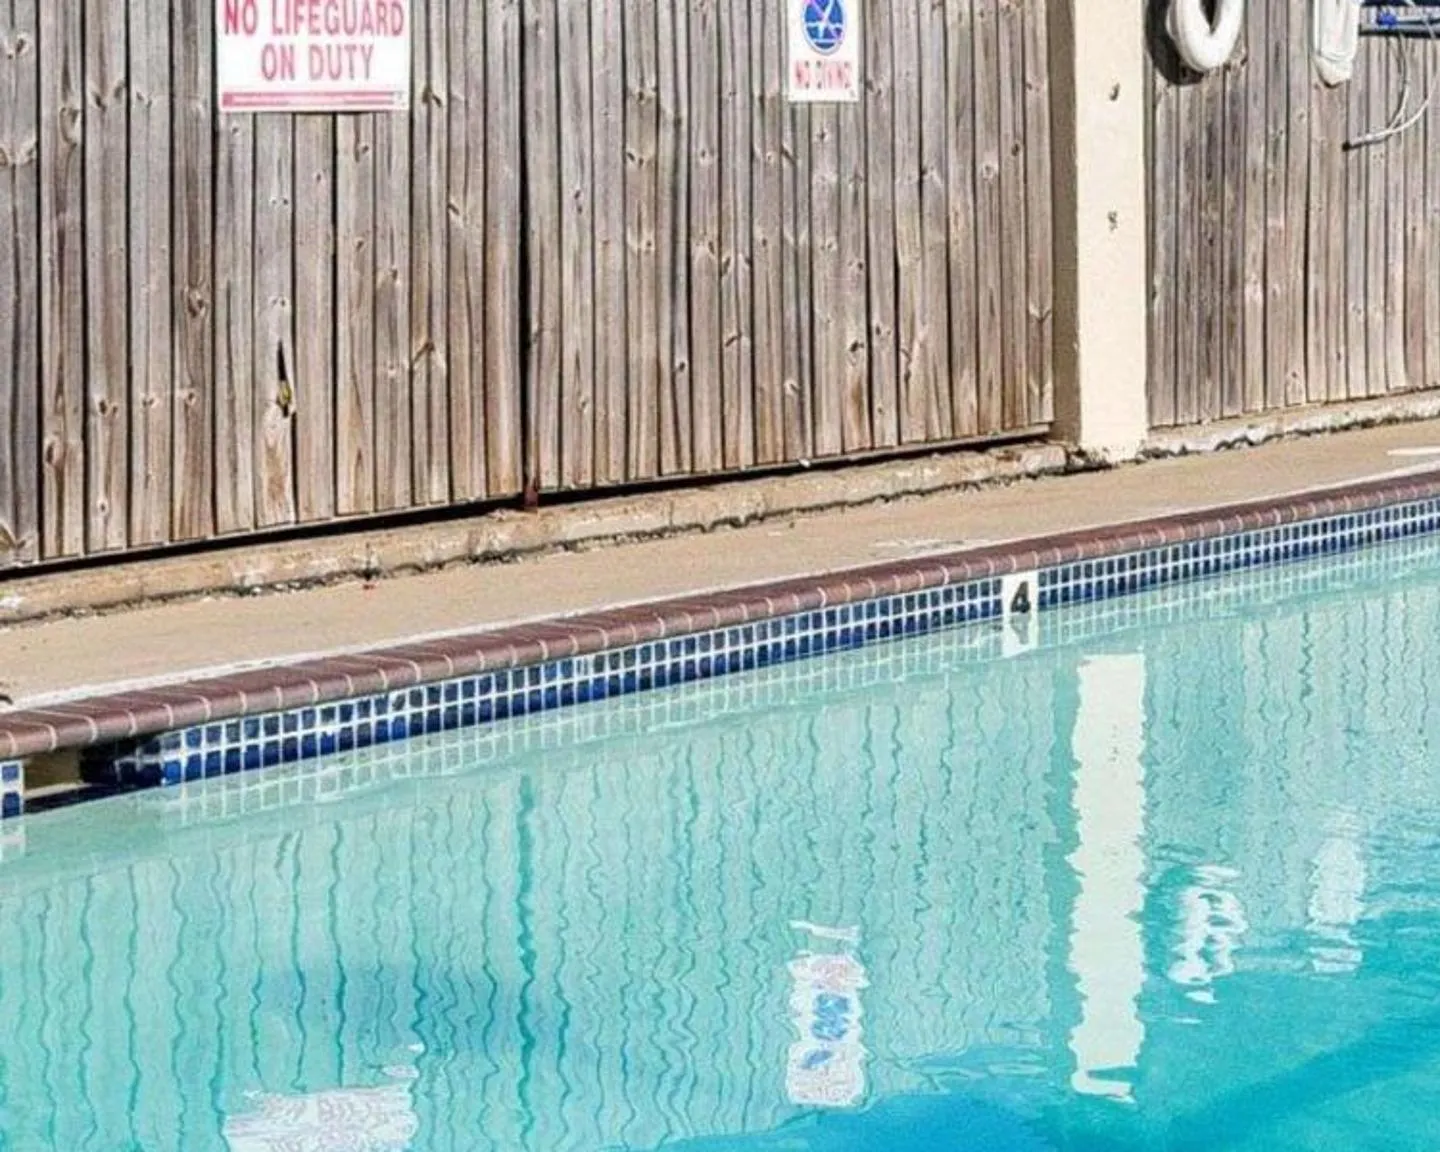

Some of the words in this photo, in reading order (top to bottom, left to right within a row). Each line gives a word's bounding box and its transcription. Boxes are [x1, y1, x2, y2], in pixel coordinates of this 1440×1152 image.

[224, 0, 258, 36] NO
[271, 0, 405, 37] LIFEGUARD
[261, 43, 296, 81] ON
[308, 43, 374, 82] DUTY
[1010, 580, 1032, 614] 4
